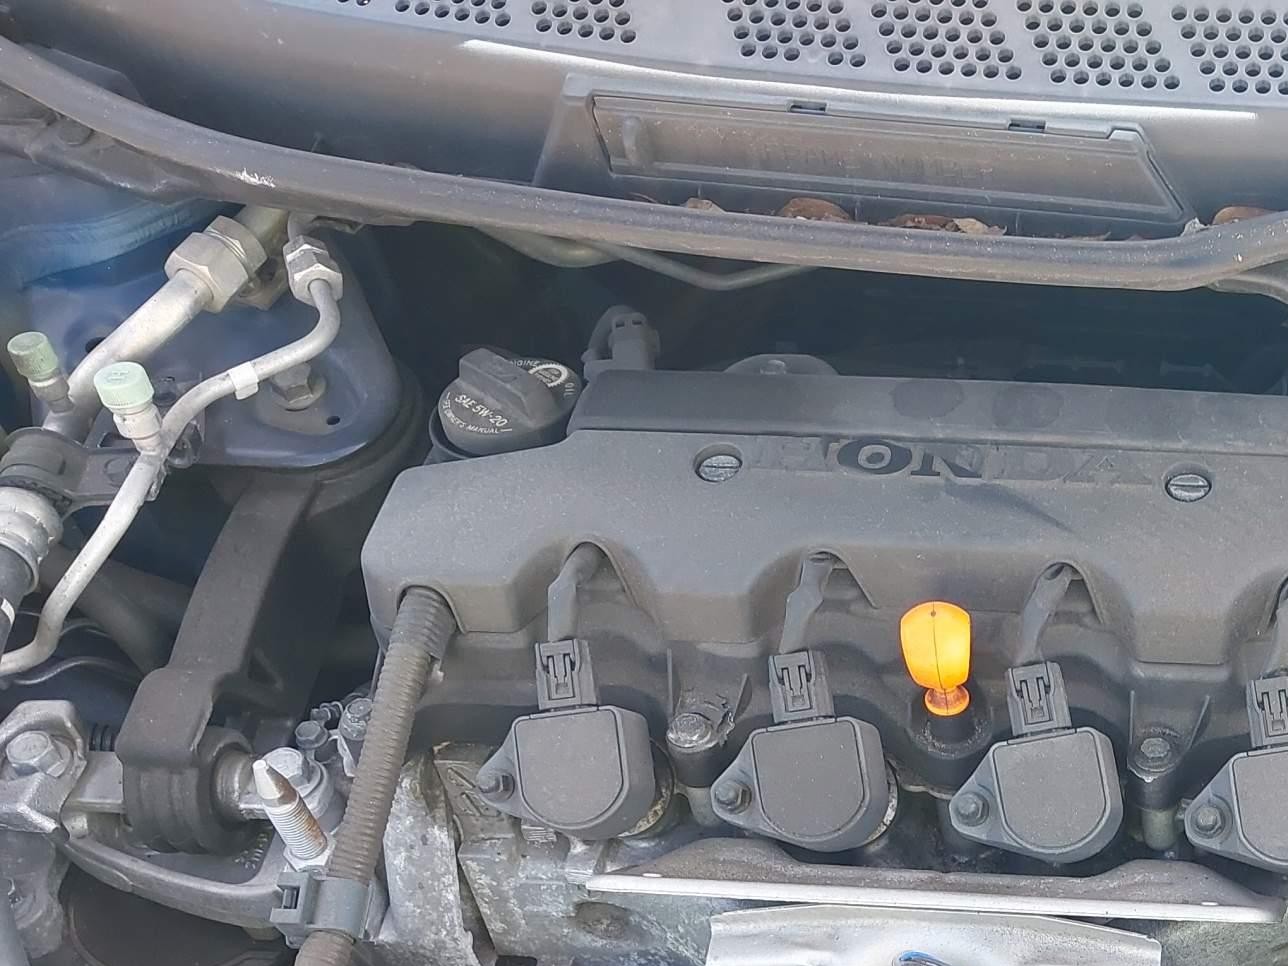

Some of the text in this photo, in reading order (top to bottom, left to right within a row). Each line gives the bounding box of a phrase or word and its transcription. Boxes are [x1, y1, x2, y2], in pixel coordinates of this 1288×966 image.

[455, 394, 508, 427] SAE 5W-20
[466, 424, 500, 434] MANUAL
[747, 436, 1150, 485] HONDA
